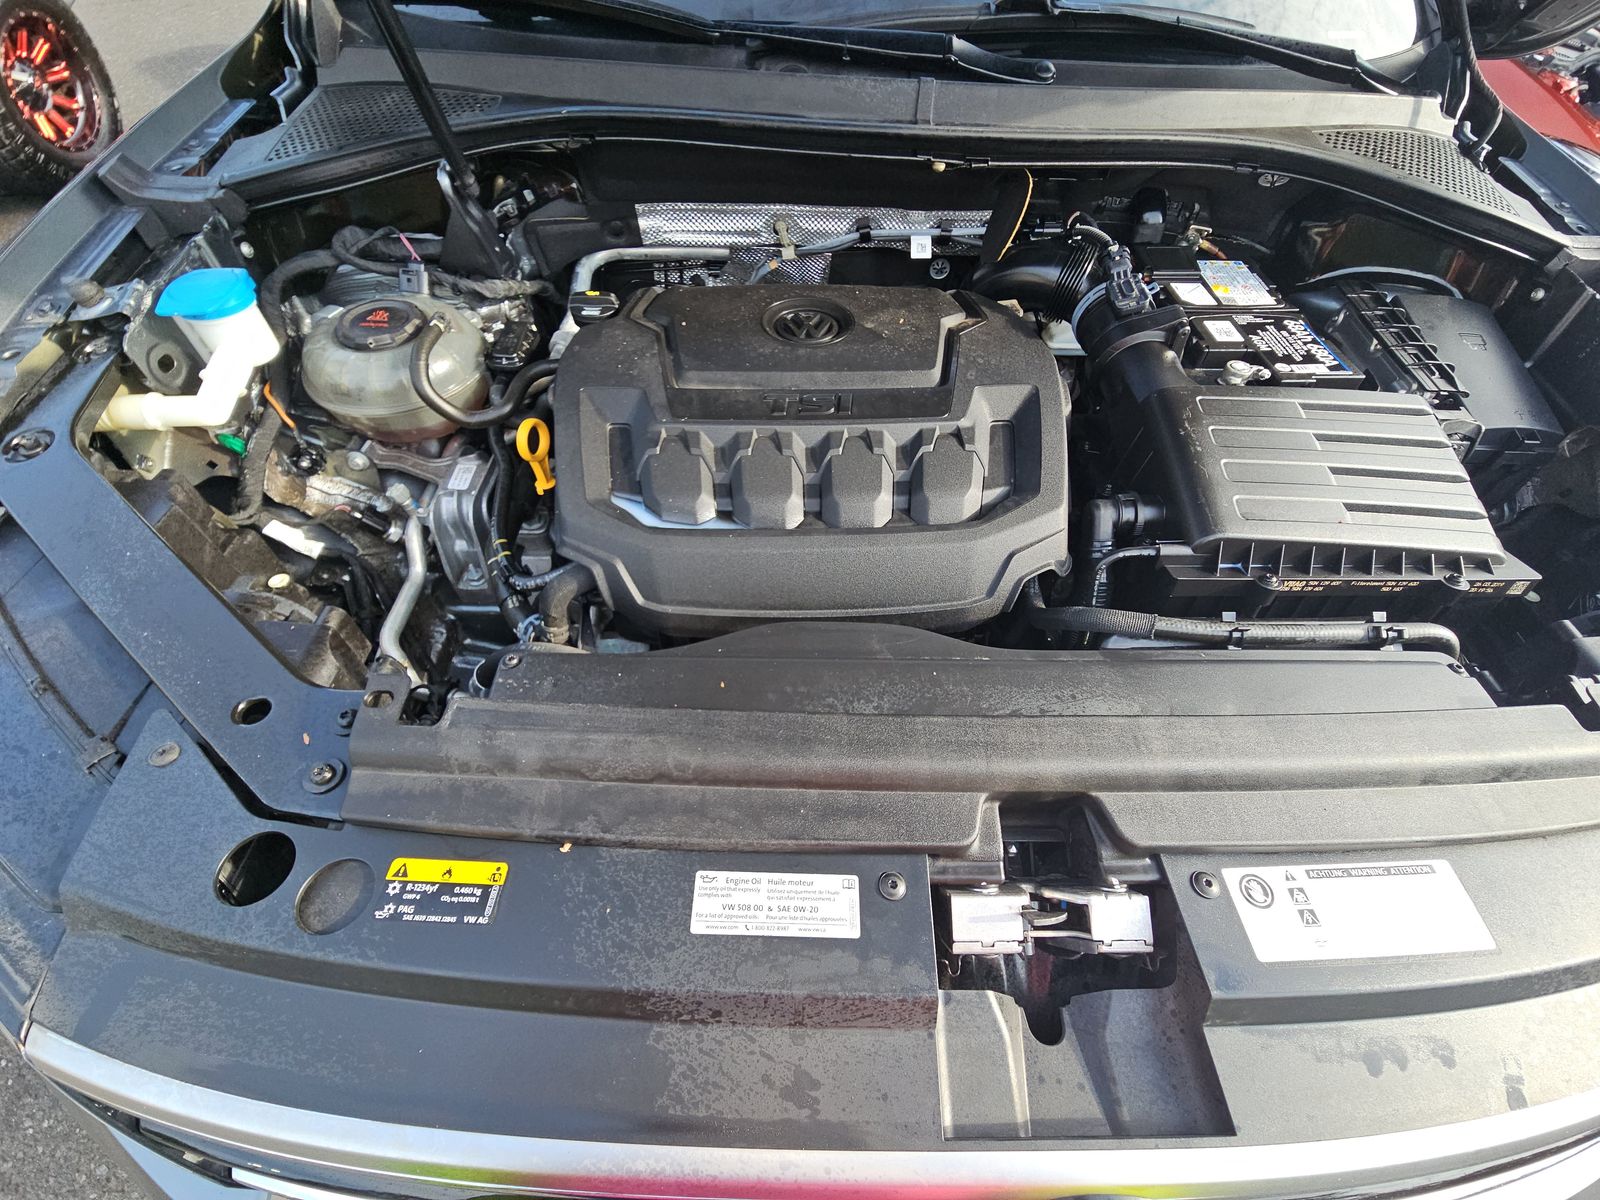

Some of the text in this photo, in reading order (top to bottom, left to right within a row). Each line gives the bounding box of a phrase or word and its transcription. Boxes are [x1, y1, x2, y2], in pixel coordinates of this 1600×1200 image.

[1248, 334, 1272, 351] AGM
[1283, 320, 1314, 342] 68Ah
[1306, 343, 1340, 367] 680A
[763, 393, 853, 416] TSI
[1309, 865, 1432, 879] ACHTUNG WARNING ATTENTION
[725, 877, 761, 886] Engine Oil
[767, 878, 814, 887] Huile moteur
[406, 883, 439, 894] R-1234yf
[454, 886, 482, 896] 0.460 kg
[397, 905, 415, 913] PAG
[721, 903, 736, 911] VW
[753, 904, 763, 912] 00
[793, 905, 819, 913] 0W-20
